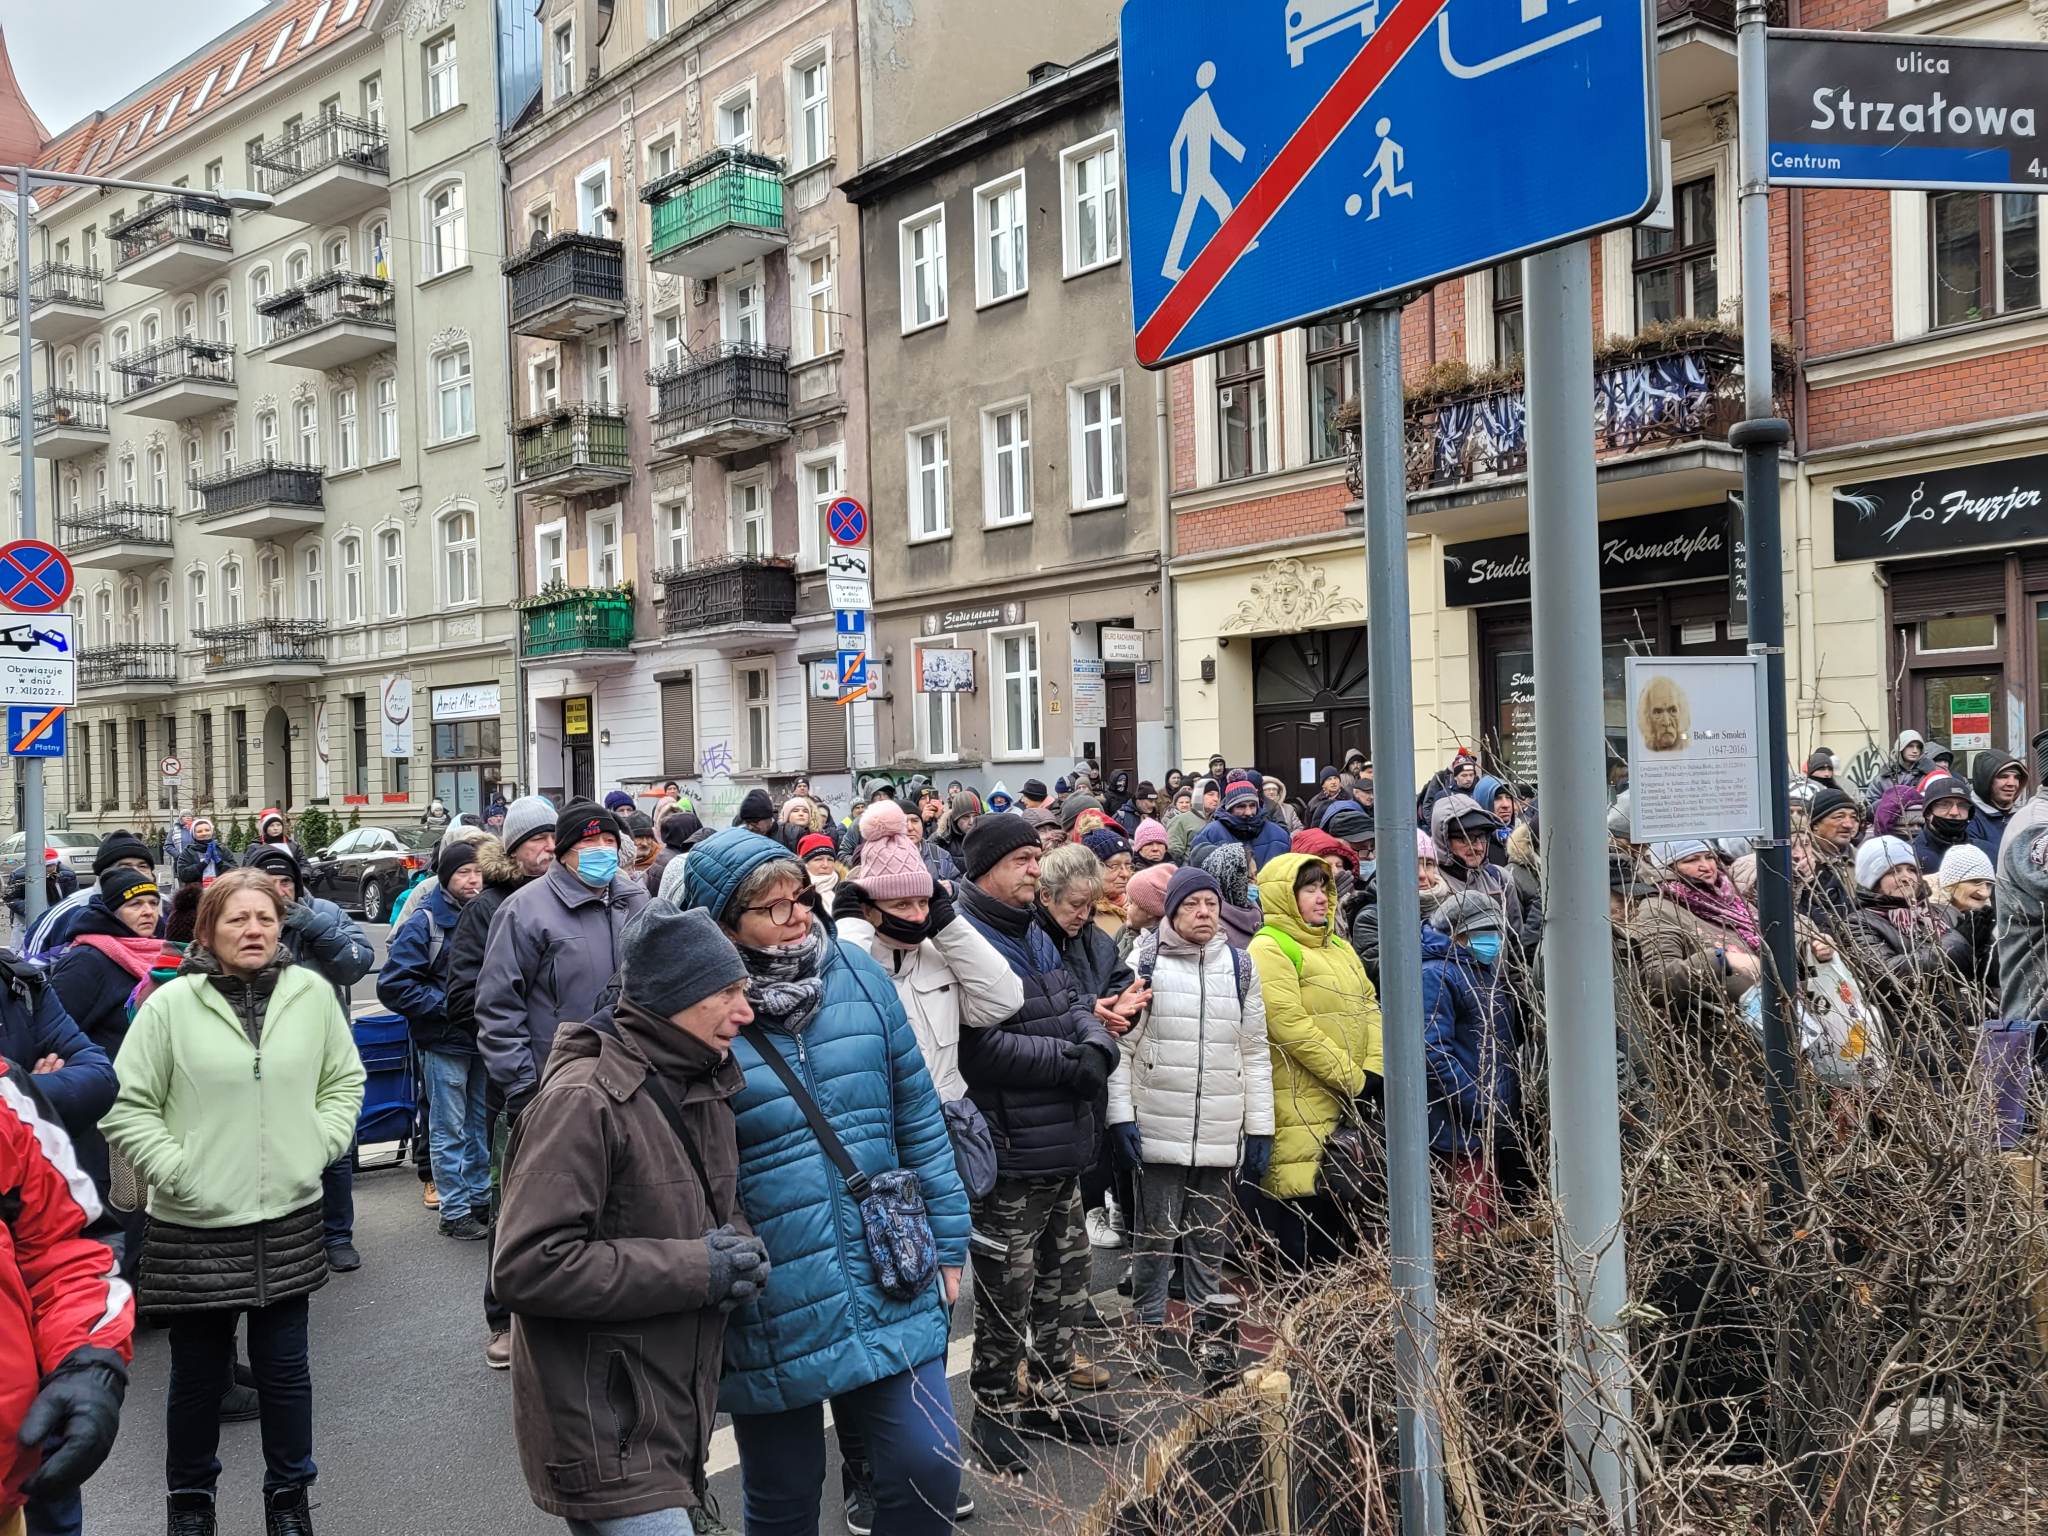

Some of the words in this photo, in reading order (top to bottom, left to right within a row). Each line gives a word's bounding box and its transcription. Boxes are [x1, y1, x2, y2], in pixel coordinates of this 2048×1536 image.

[1896, 51, 1950, 74] ulica
[1810, 87, 2036, 137] Strzałowa
[1771, 152, 1841, 170] Centrum
[1940, 486, 2042, 524] Fryzjer
[1467, 554, 1531, 584] Studio
[1602, 526, 1723, 565] Kosmetyka
[30, 676, 52, 685] dniu
[436, 694, 459, 713] Amici
[1721, 729, 1747, 740] Smoleń
